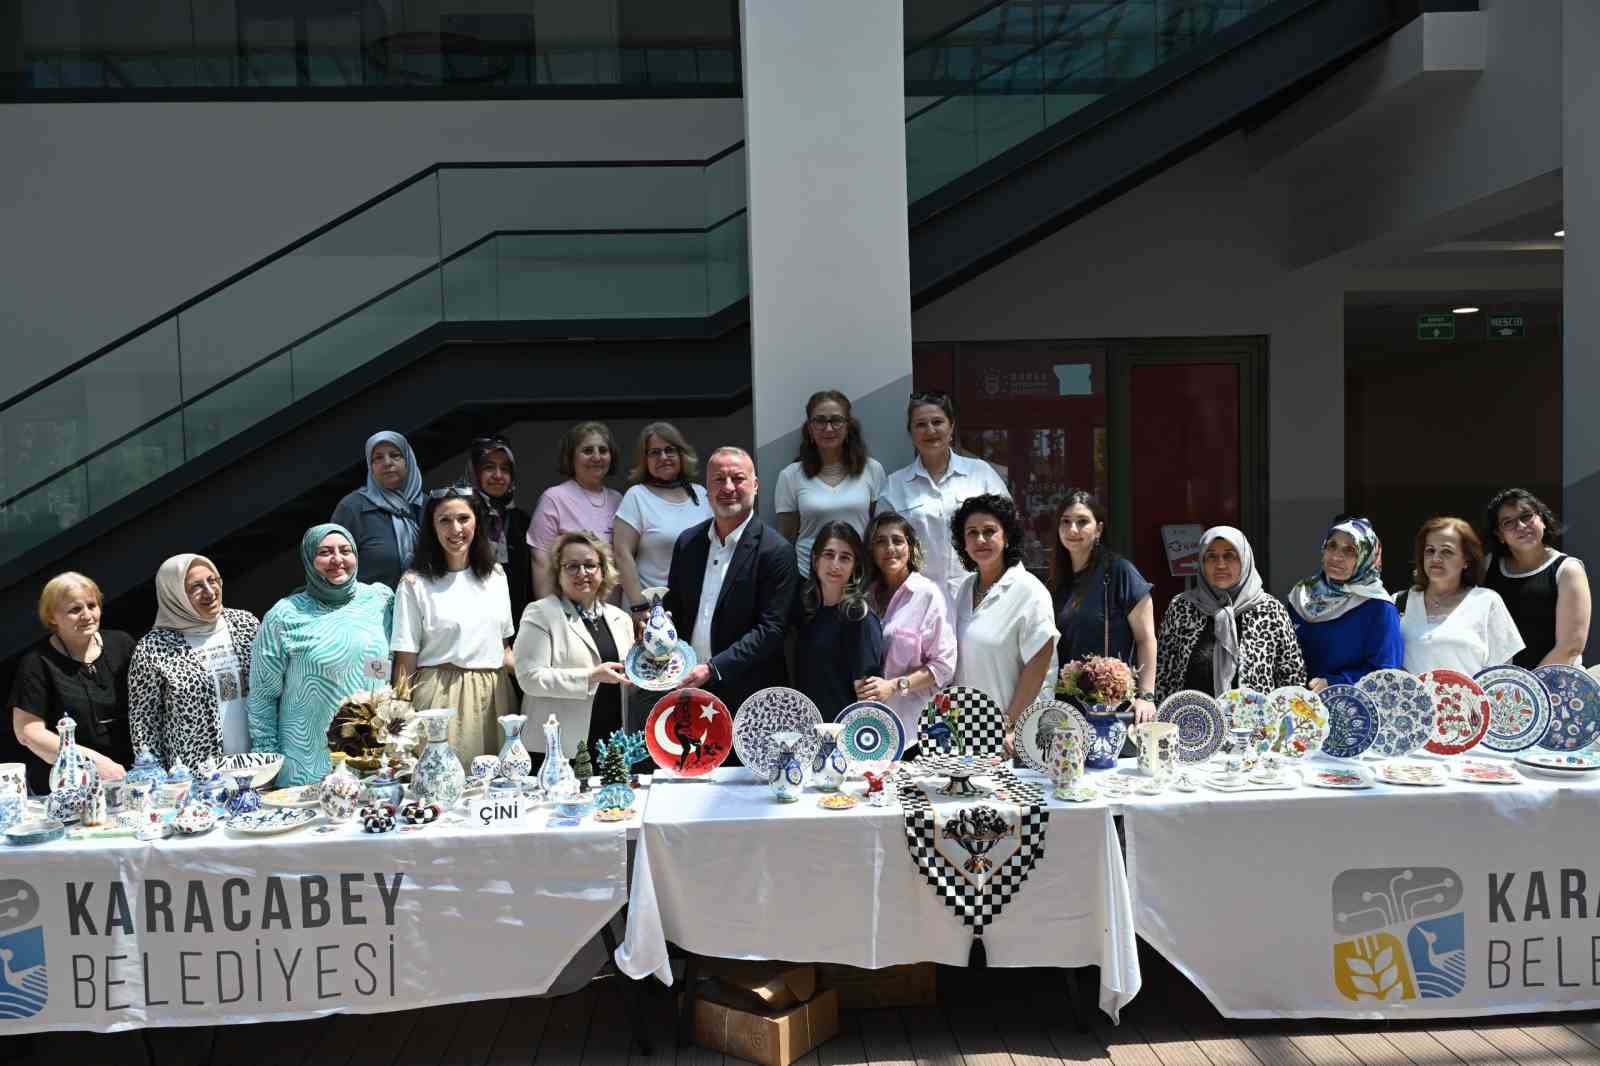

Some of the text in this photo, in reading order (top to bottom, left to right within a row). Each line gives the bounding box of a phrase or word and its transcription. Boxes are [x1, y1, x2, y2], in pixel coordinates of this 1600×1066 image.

[480, 801, 518, 825] ÇİNİ
[66, 872, 404, 935] KARACABEY
[1488, 868, 1600, 923] KAR
[72, 934, 397, 1010] BELEDİYESİ
